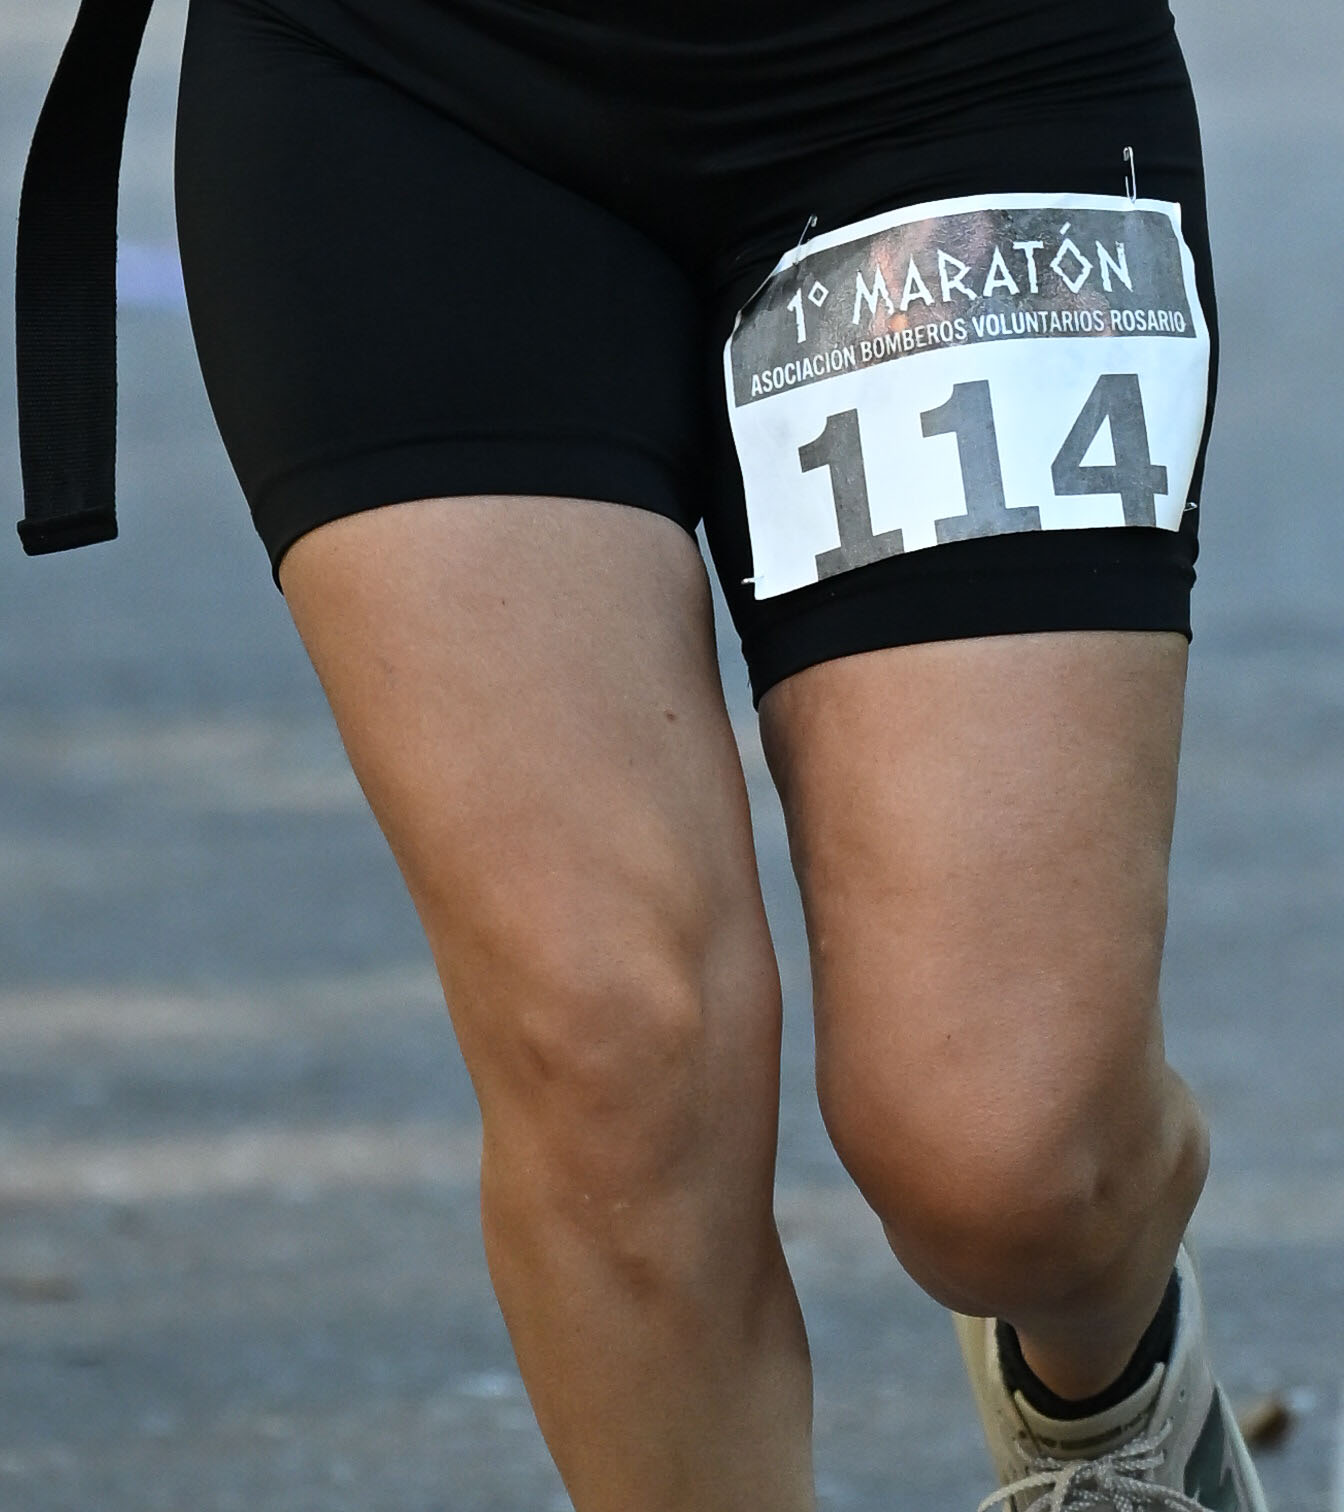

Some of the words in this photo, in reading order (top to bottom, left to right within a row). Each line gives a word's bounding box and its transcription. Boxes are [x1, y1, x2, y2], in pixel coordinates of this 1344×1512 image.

[852, 223, 1133, 325] MARATÓN
[750, 344, 856, 397] ASOCIACIÓN
[860, 320, 968, 362] BOMBEROS
[971, 310, 1104, 337] VOLUNTARIOS
[1110, 309, 1186, 333] ROSARIO
[797, 373, 1169, 581] 114
